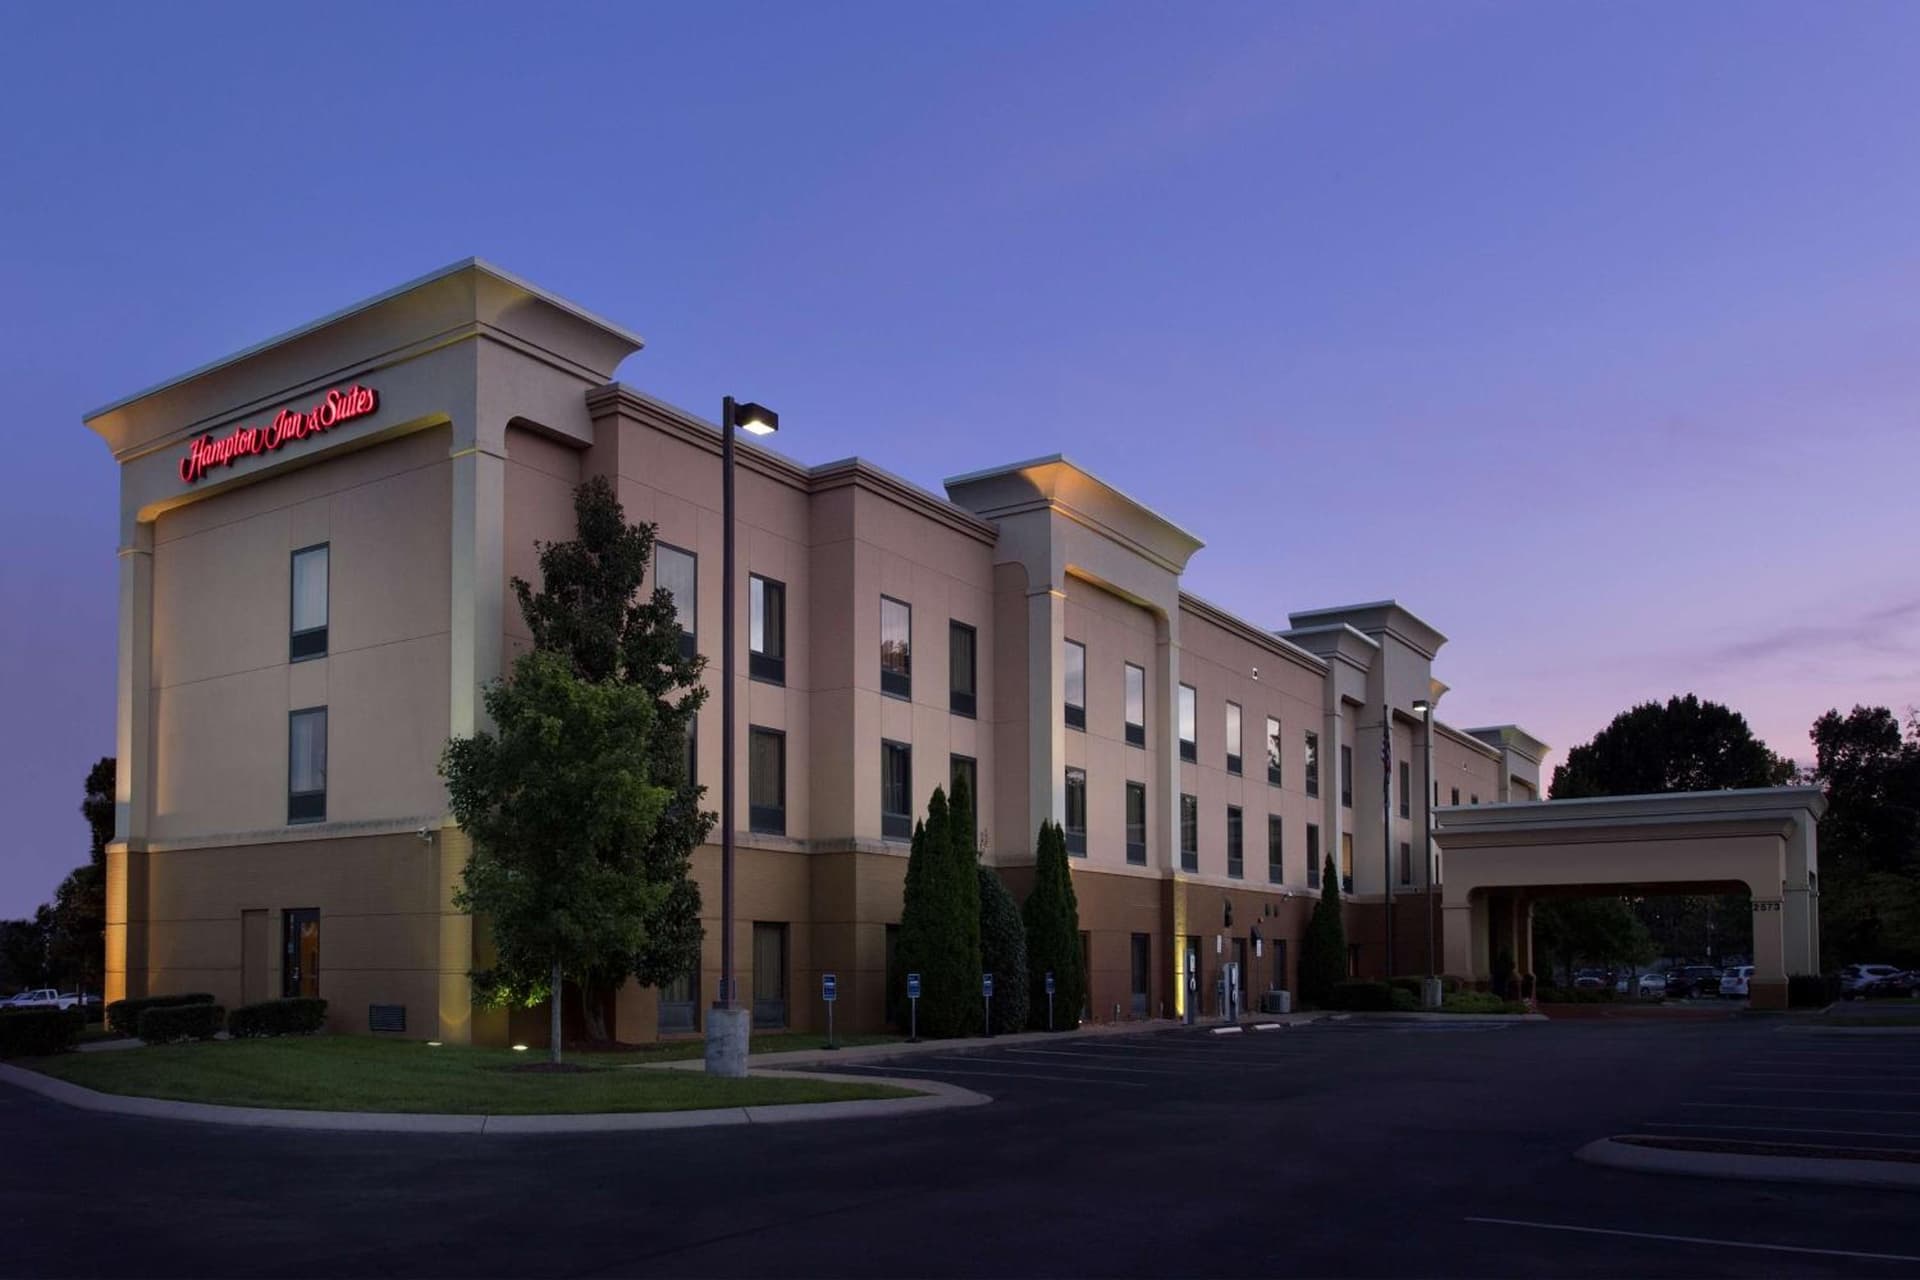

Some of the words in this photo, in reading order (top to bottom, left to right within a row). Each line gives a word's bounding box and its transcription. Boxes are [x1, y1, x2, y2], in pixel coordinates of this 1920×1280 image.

[179, 426, 264, 482] Hampton
[265, 409, 309, 449] Inn
[308, 409, 321, 431] &
[320, 385, 376, 425] Suites
